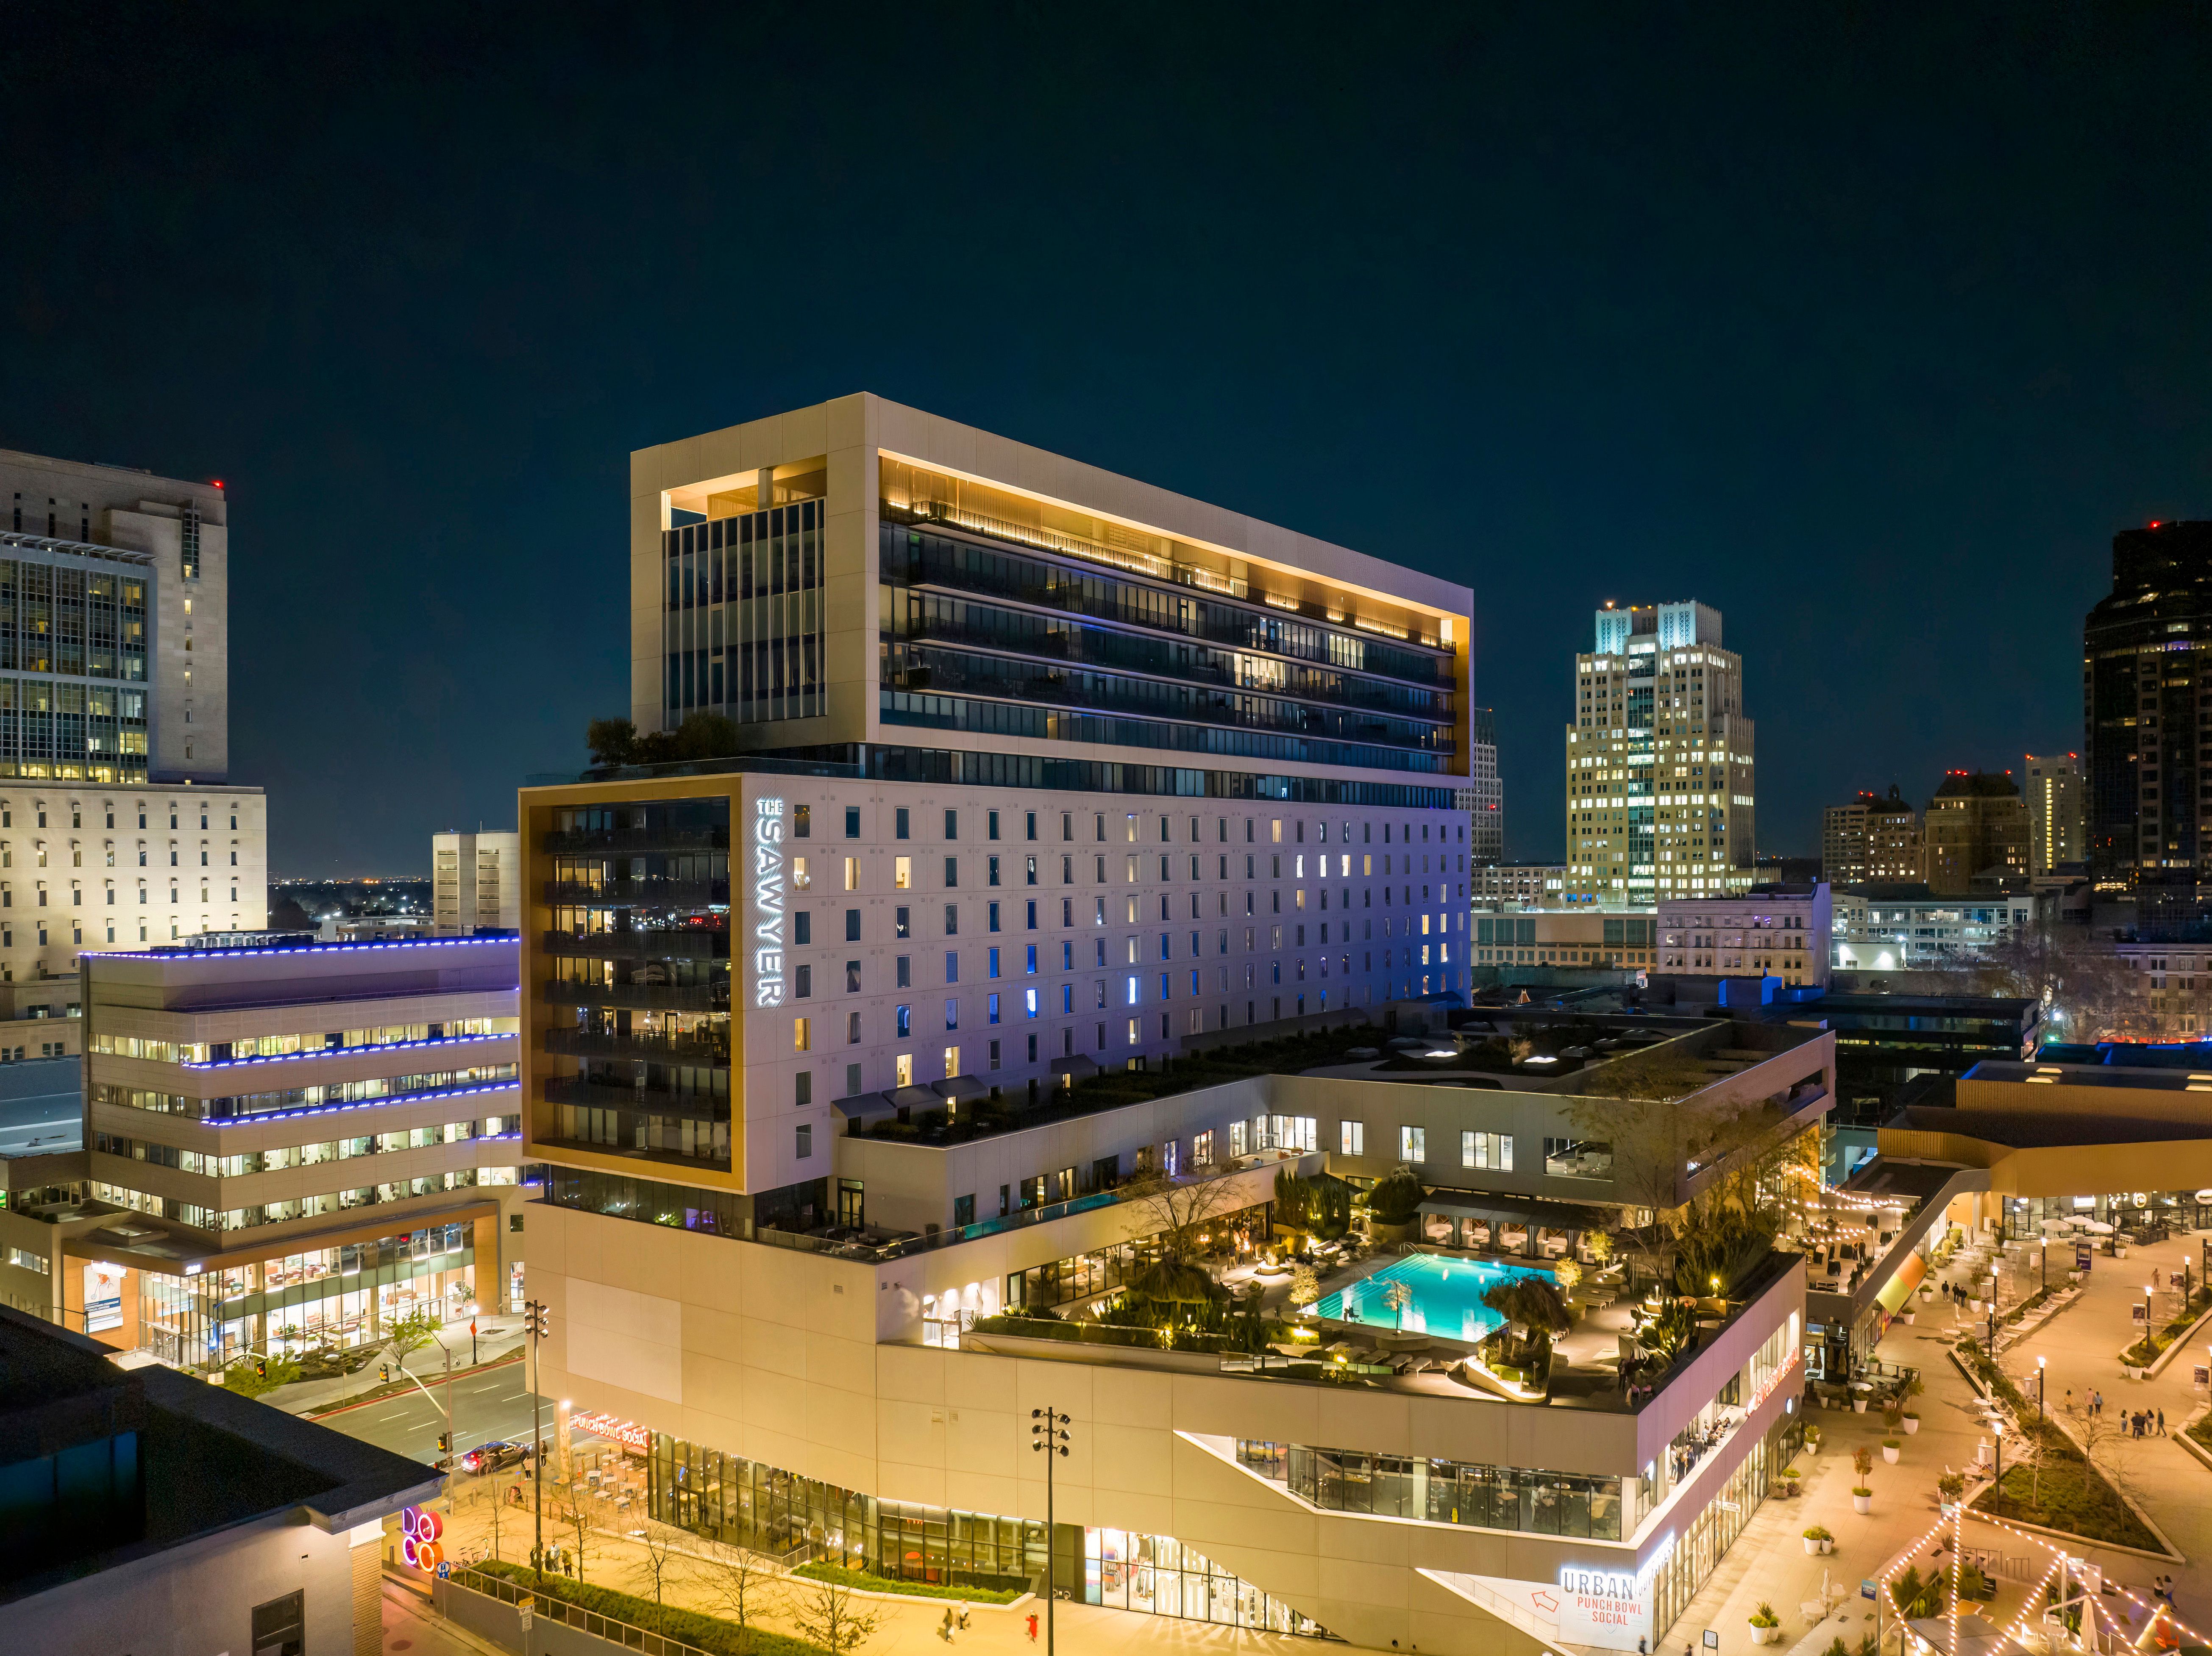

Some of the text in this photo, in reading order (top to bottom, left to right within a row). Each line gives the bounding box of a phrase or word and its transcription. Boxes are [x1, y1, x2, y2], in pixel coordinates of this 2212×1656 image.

[759, 800, 783, 813] THE
[760, 819, 784, 1005] SAWYER
[574, 1414, 648, 1448] PUNCH BOWL SOCIAL
[1564, 1572, 1633, 1600] URBAN
[1578, 1597, 1642, 1615] PUNCH BOWL
[1592, 1611, 1628, 1625] SOCIAL
